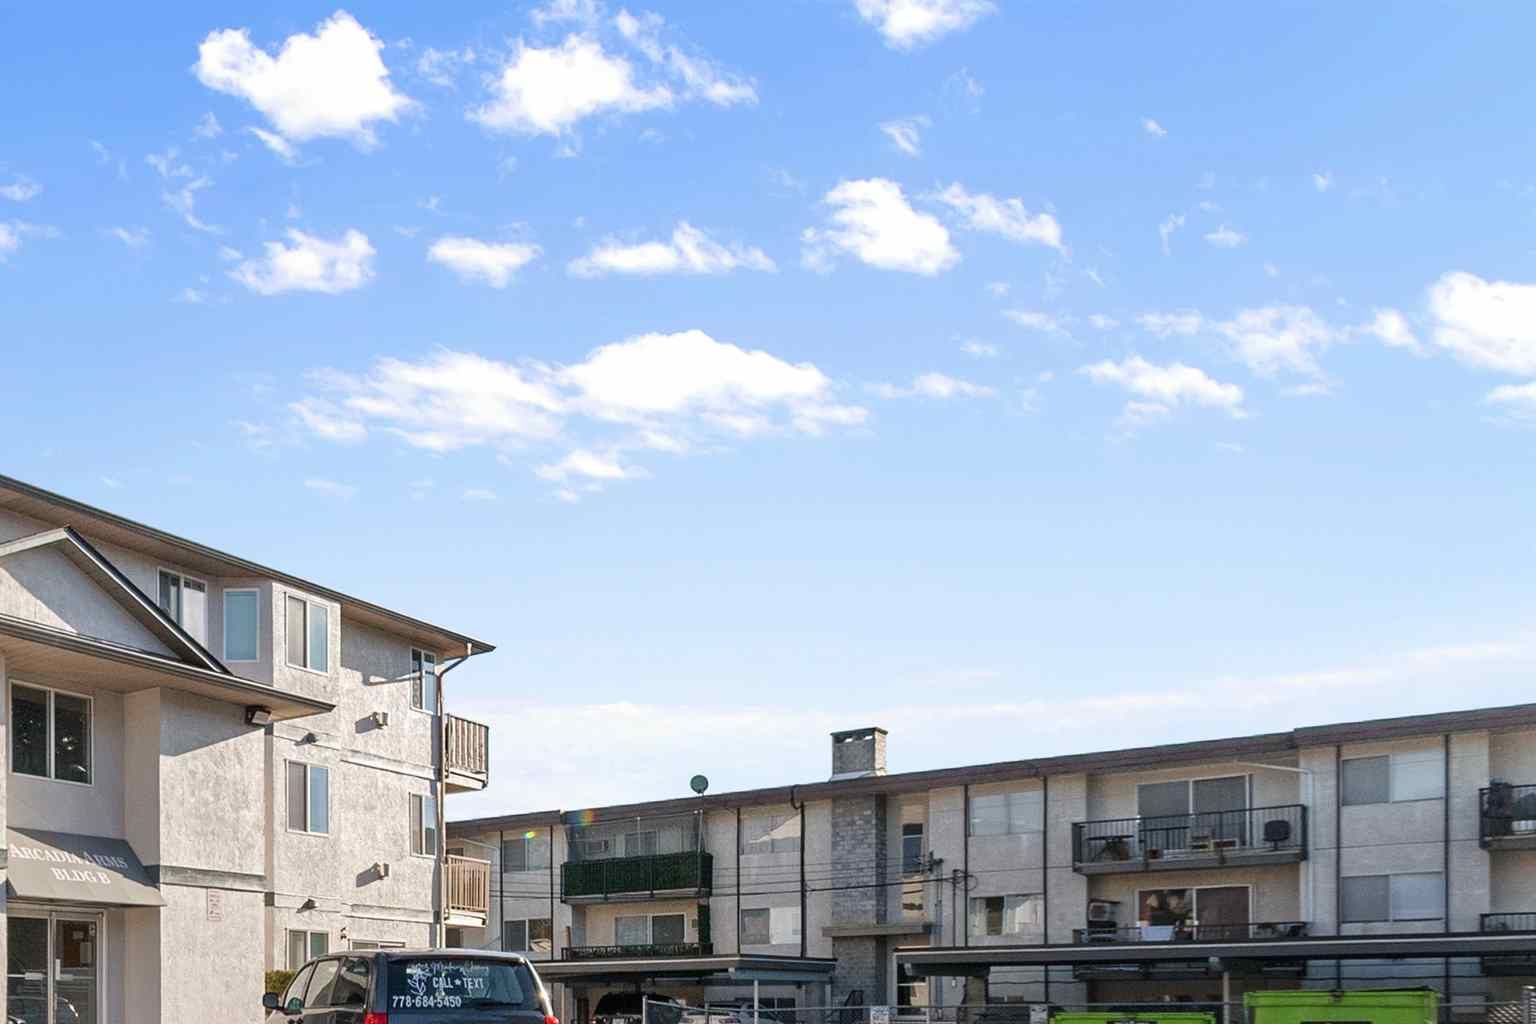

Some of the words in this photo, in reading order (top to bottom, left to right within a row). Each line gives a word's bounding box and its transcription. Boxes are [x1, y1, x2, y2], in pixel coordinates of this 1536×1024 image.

[7, 843, 83, 865] ARCADIA
[83, 851, 129, 869] ARMS
[50, 867, 96, 881] BLDG
[96, 871, 111, 884] B
[432, 977, 454, 989] CALL
[463, 978, 484, 989] TEXT
